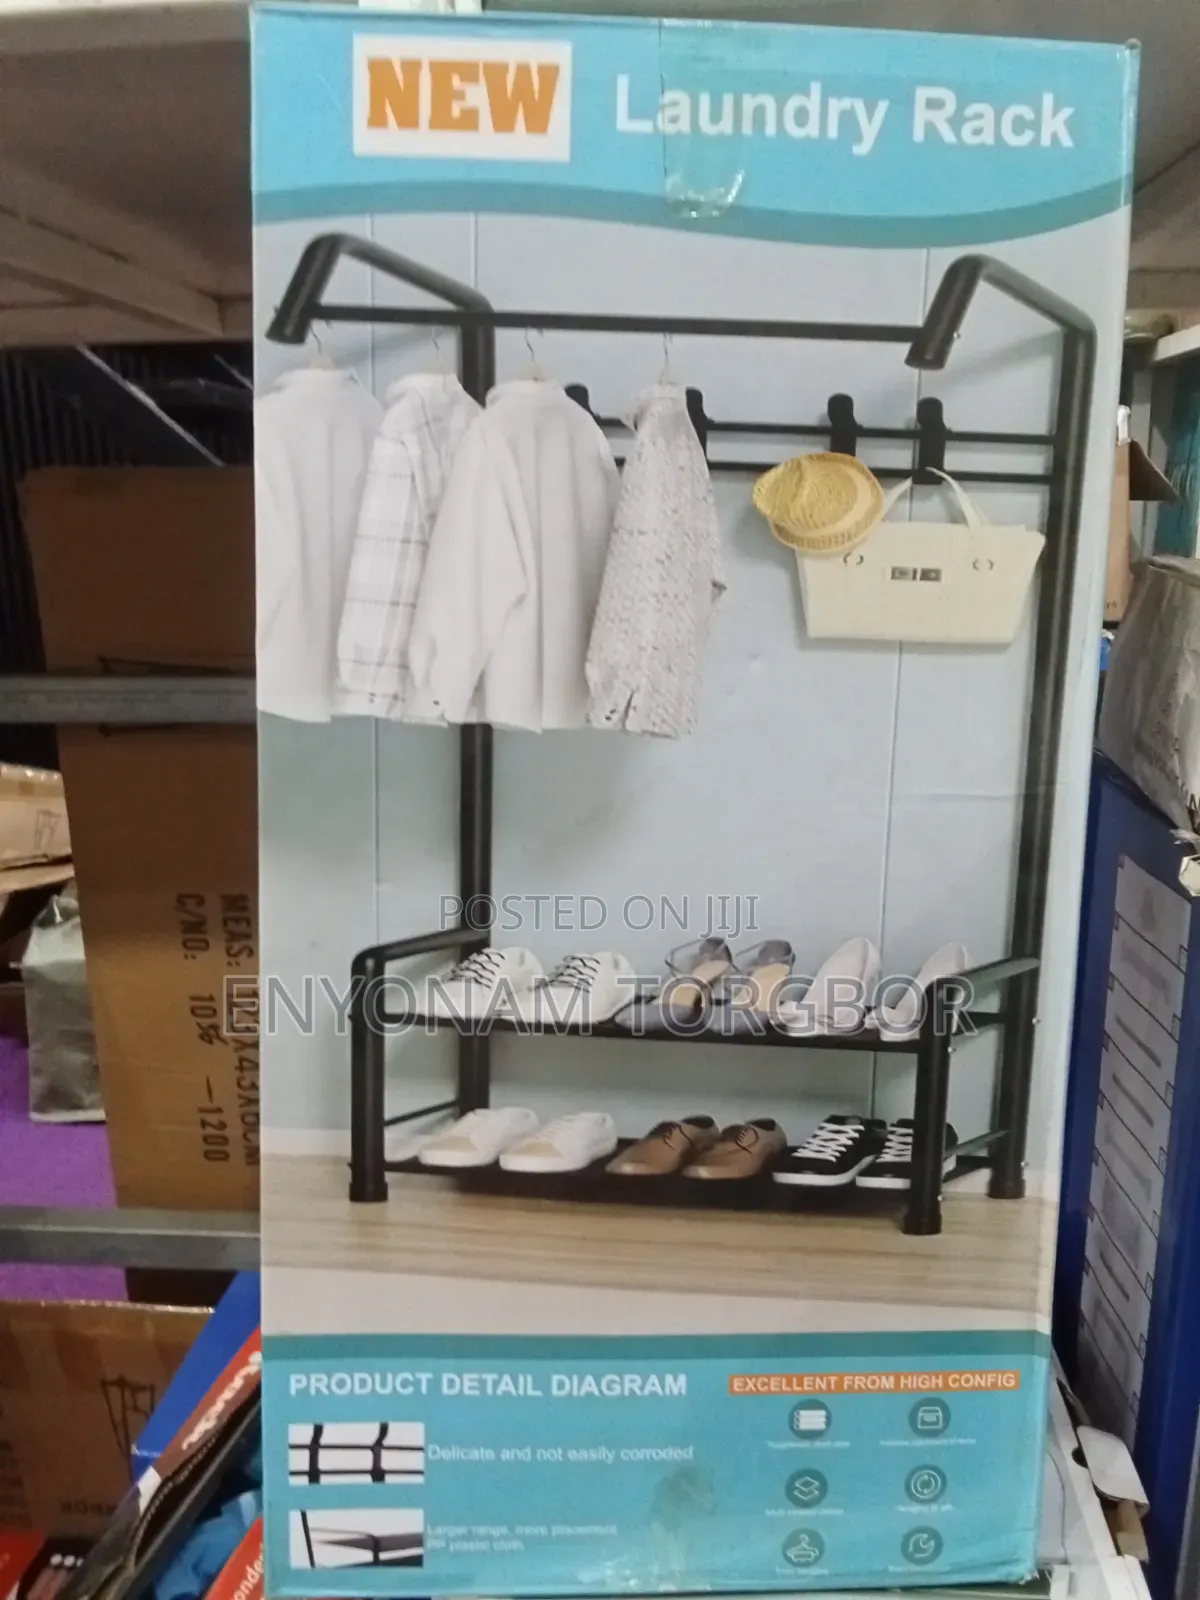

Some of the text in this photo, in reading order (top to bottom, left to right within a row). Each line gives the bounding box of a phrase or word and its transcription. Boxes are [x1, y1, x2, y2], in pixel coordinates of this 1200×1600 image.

[366, 57, 560, 136] NEW
[615, 73, 1076, 156] Laundry Rack
[289, 1372, 688, 1397] PRODUCT DETAIL DIAGRAM
[732, 1372, 1017, 1392] EXCELLENT FROM HIGH CONFIG
[428, 1443, 496, 1462] Delicate
[500, 1445, 532, 1462] and
[536, 1446, 564, 1462] not
[567, 1446, 615, 1465] easily
